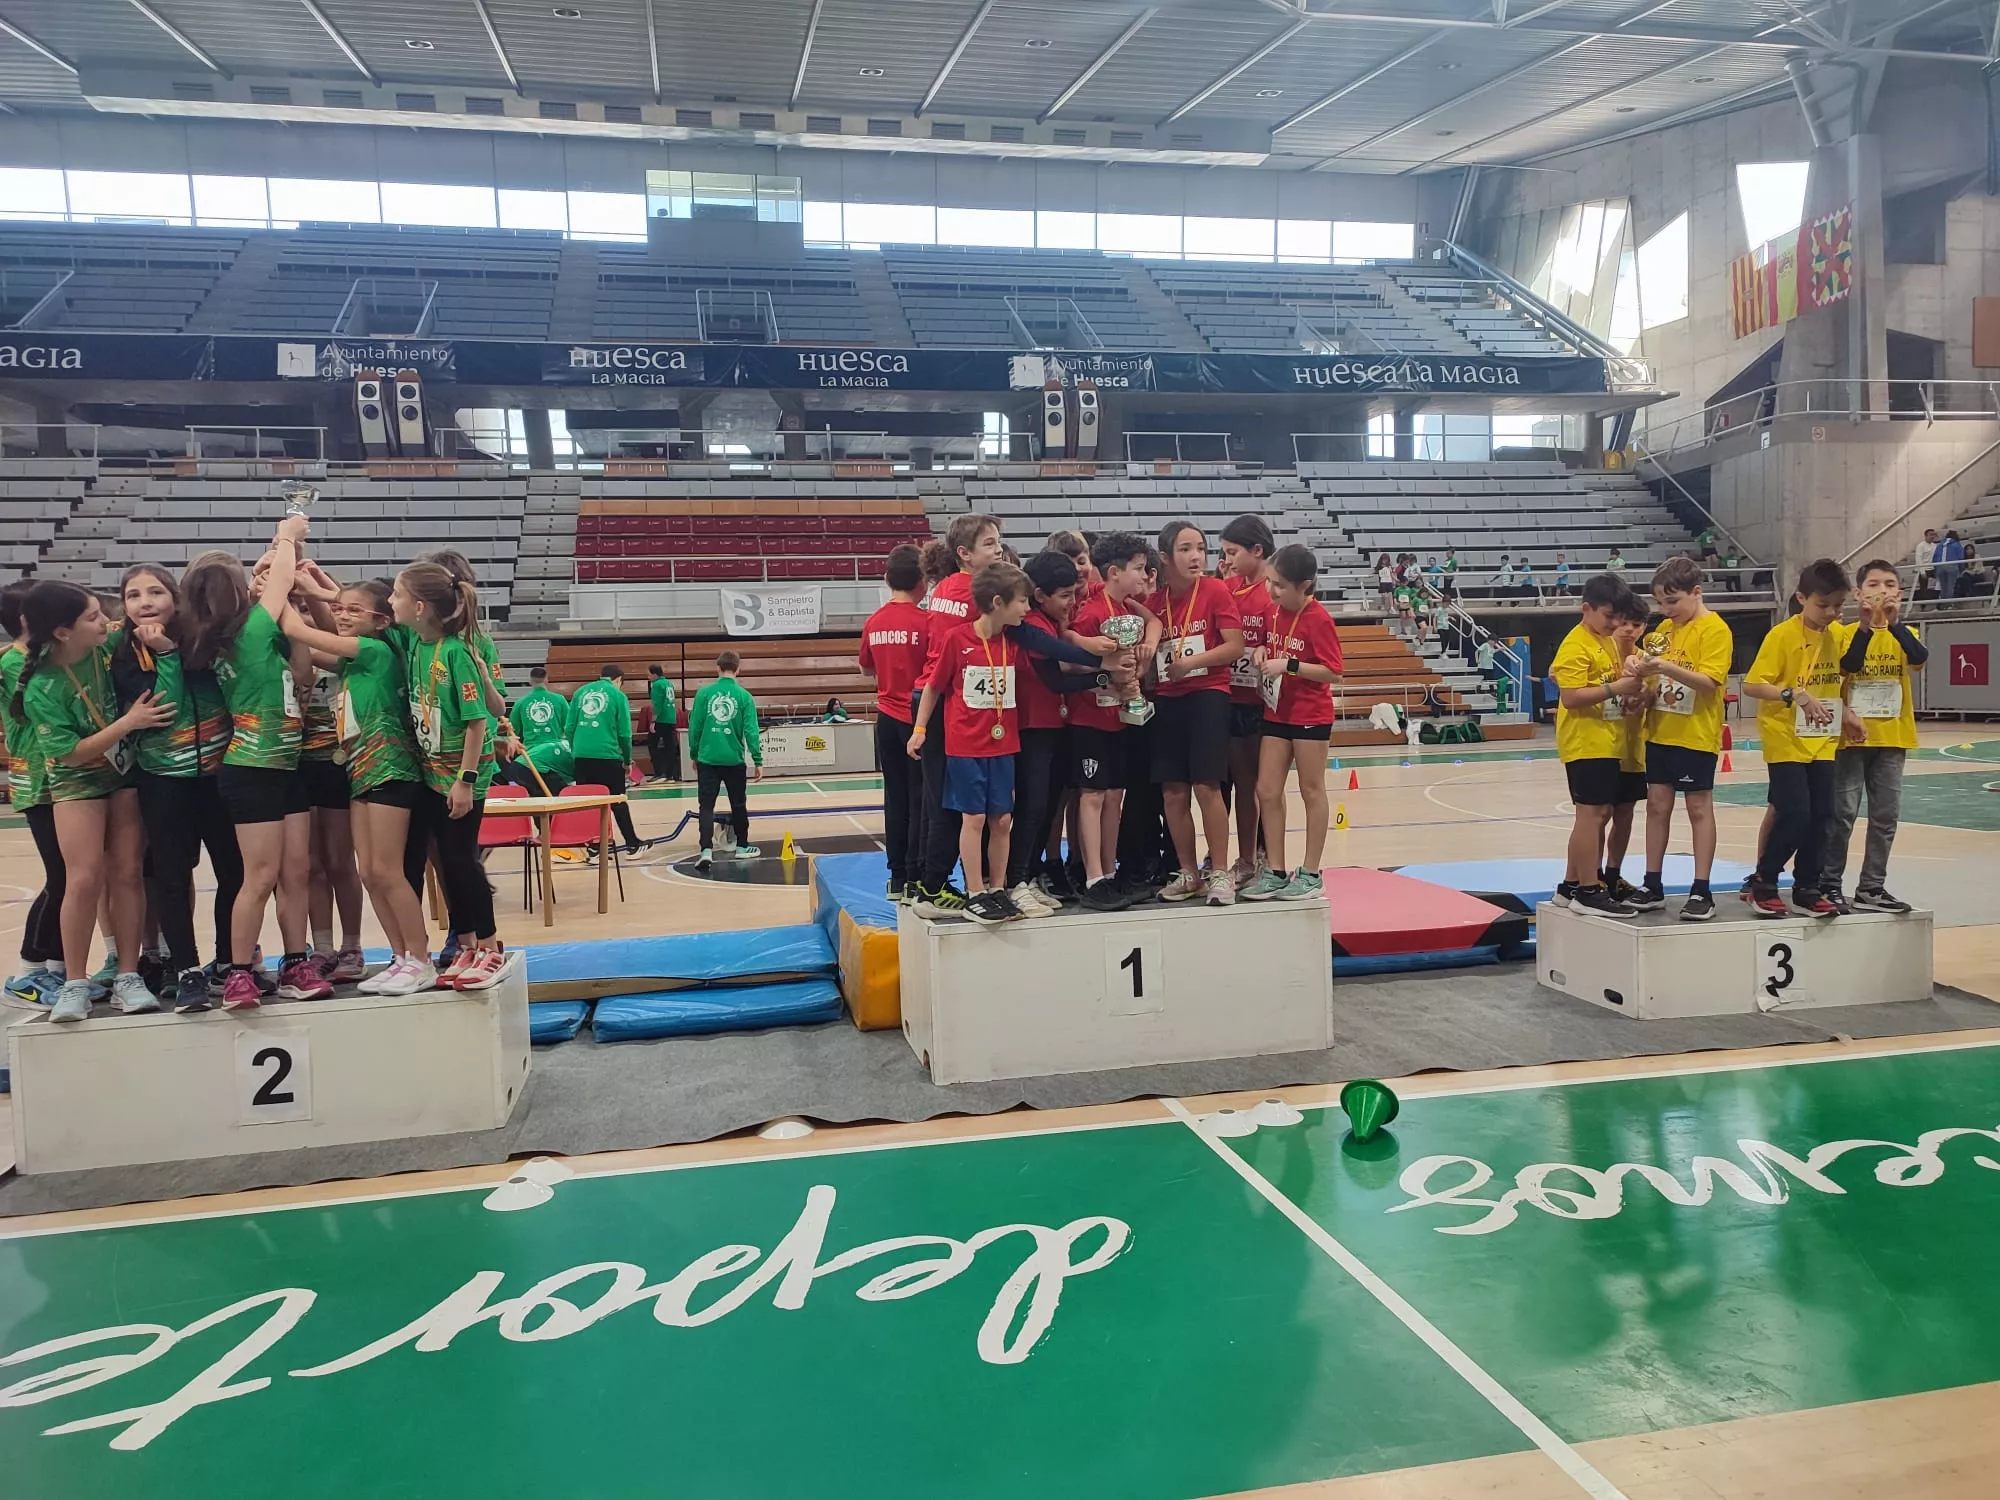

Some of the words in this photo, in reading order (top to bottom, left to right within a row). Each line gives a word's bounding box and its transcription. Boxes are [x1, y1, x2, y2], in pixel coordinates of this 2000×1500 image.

[322, 344, 448, 364] Ayuntamiento
[568, 347, 688, 369] Huesca
[797, 351, 910, 373] Huesca
[322, 365, 344, 378] de
[1060, 357, 1152, 371] yuntamiento
[1292, 362, 1399, 386] Huesca
[767, 596, 814, 606] Sampietro
[778, 607, 815, 617] Baptista
[869, 631, 907, 646] MARCOS
[911, 631, 919, 645] F.
[974, 678, 1006, 696] 433
[1336, 812, 1344, 825] 0
[1120, 947, 1143, 998] 1
[1766, 943, 1794, 997] 3
[252, 1047, 294, 1106] 2
